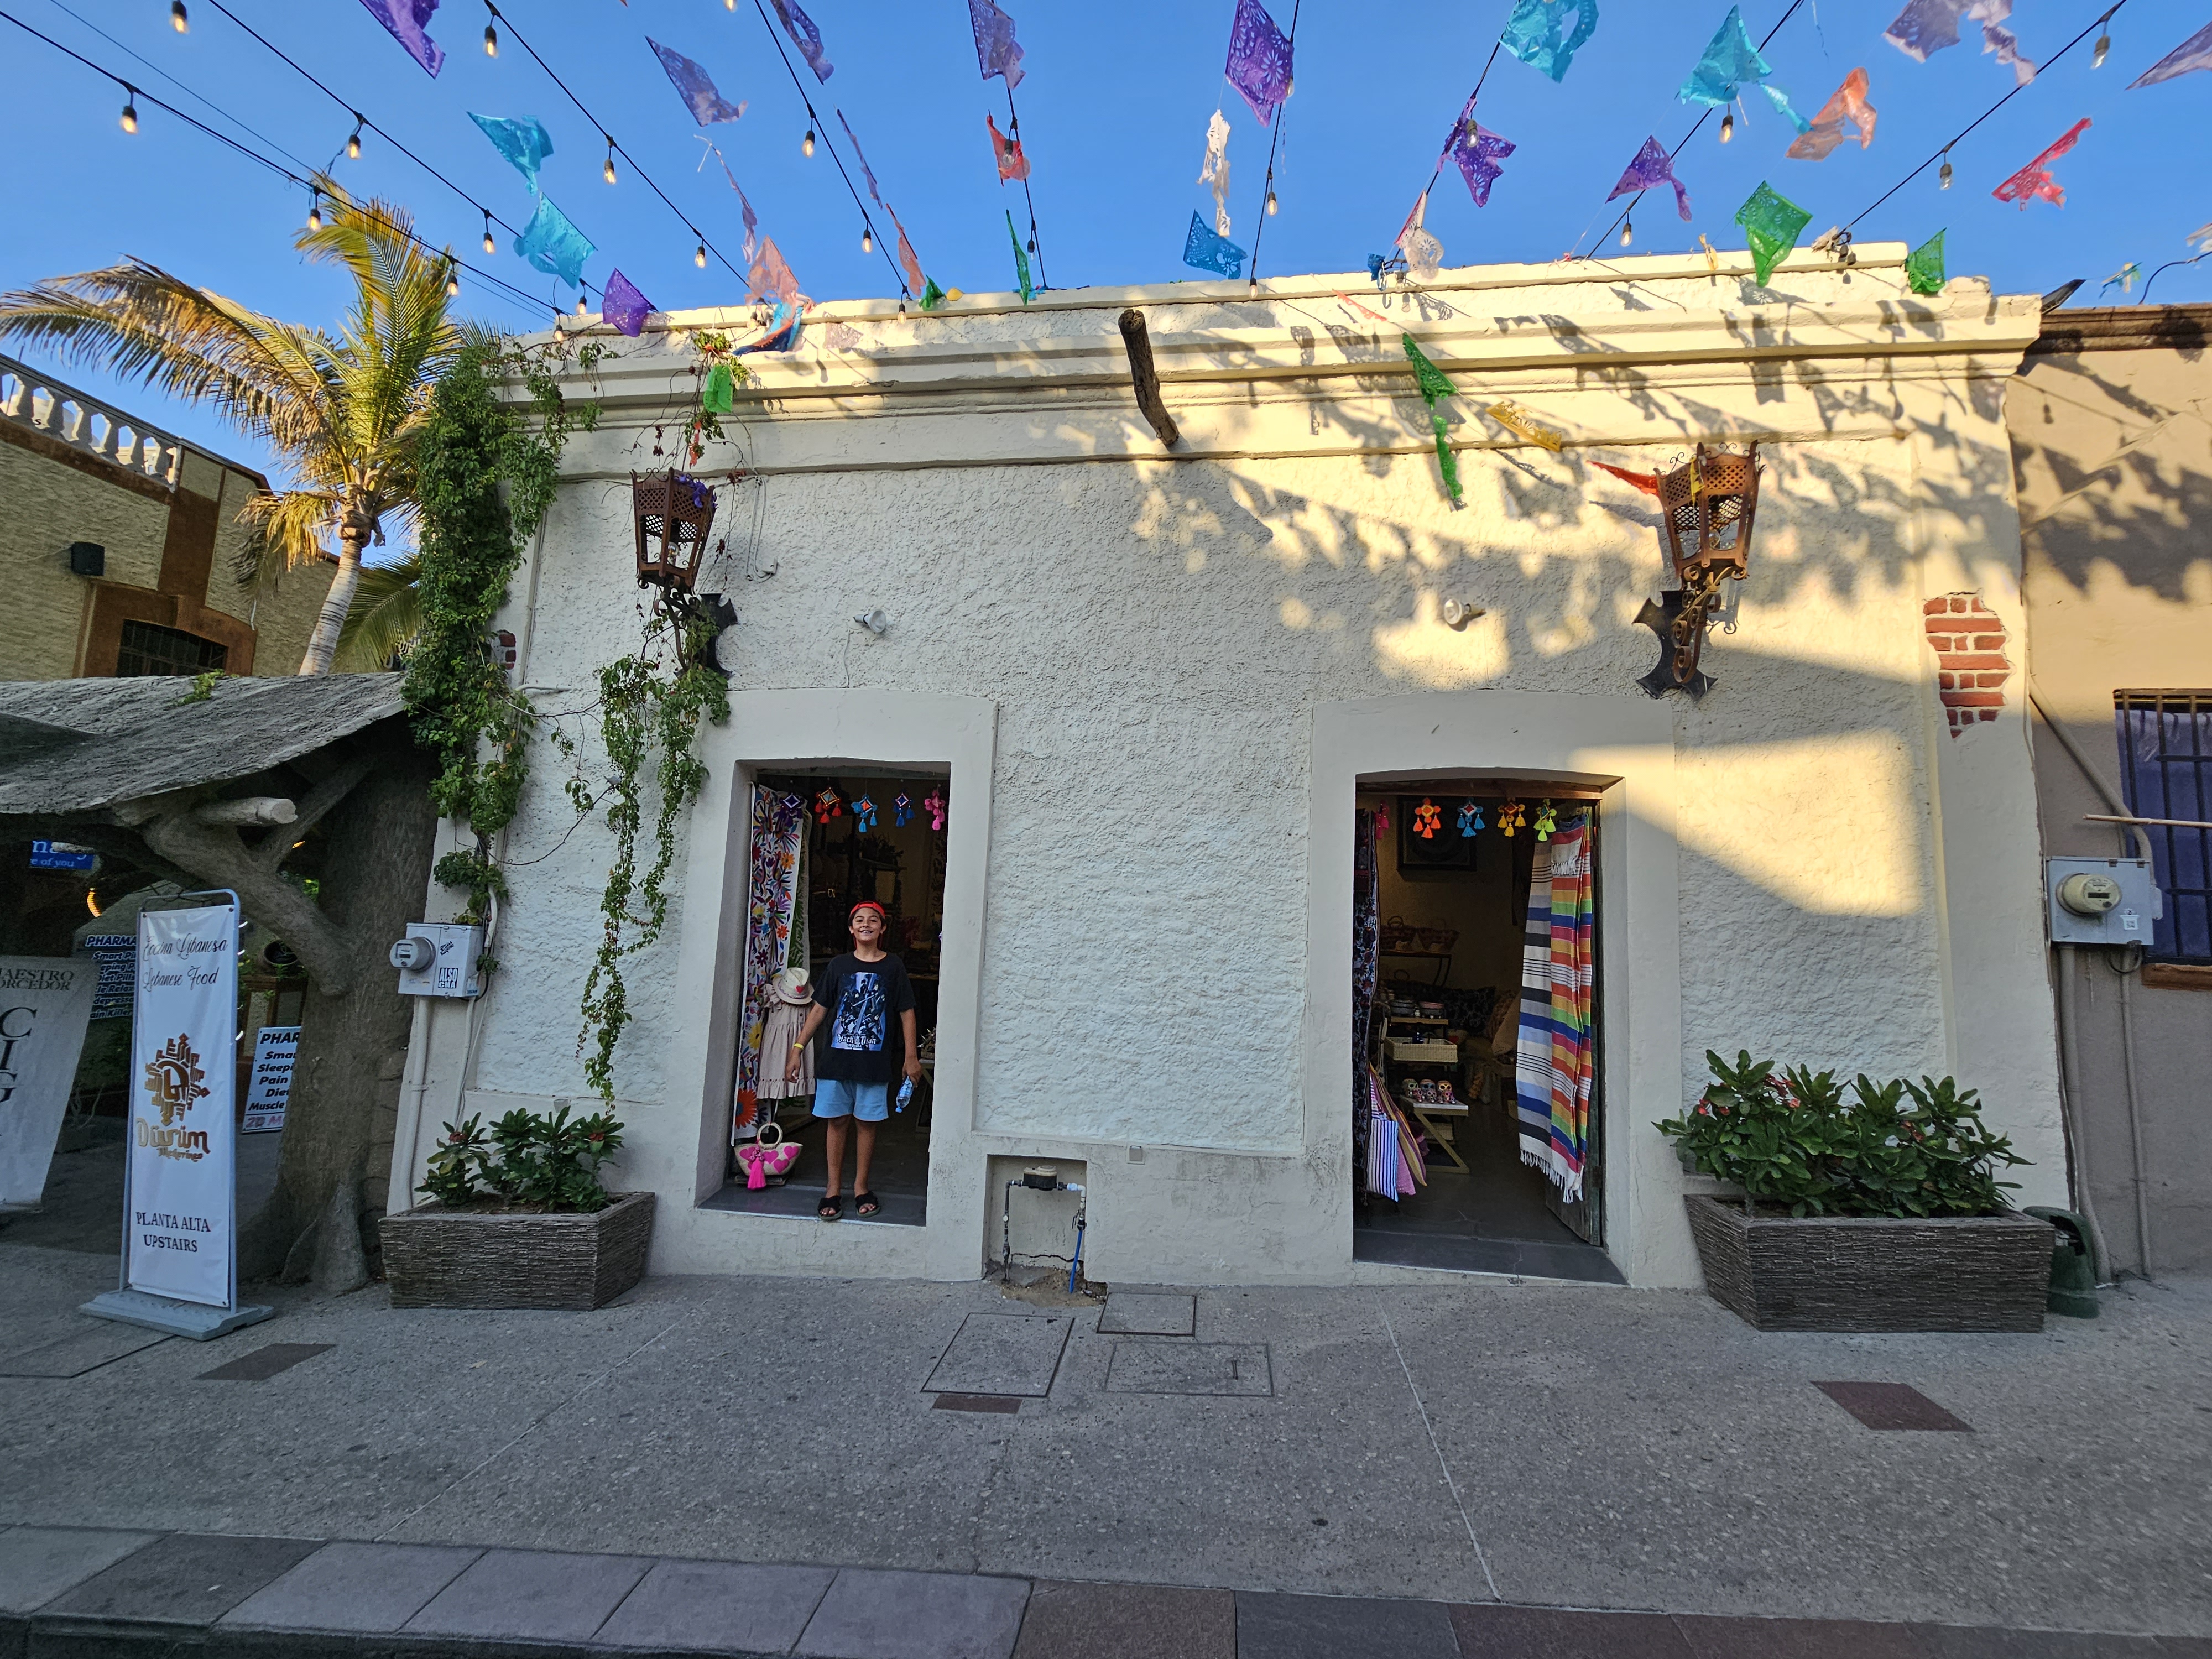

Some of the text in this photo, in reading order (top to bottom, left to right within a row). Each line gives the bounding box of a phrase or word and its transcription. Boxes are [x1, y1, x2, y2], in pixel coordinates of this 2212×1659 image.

[176, 933, 228, 960] Libanesa
[0, 968, 74, 981] AESTRO
[143, 966, 220, 992] Lebanese Food
[440, 968, 457, 982] ALSO
[259, 1076, 288, 1085] Pain
[248, 1101, 285, 1110] Muscle
[135, 1212, 211, 1232] PLANTA ALTA
[143, 1234, 197, 1253] UPSTAIRS
